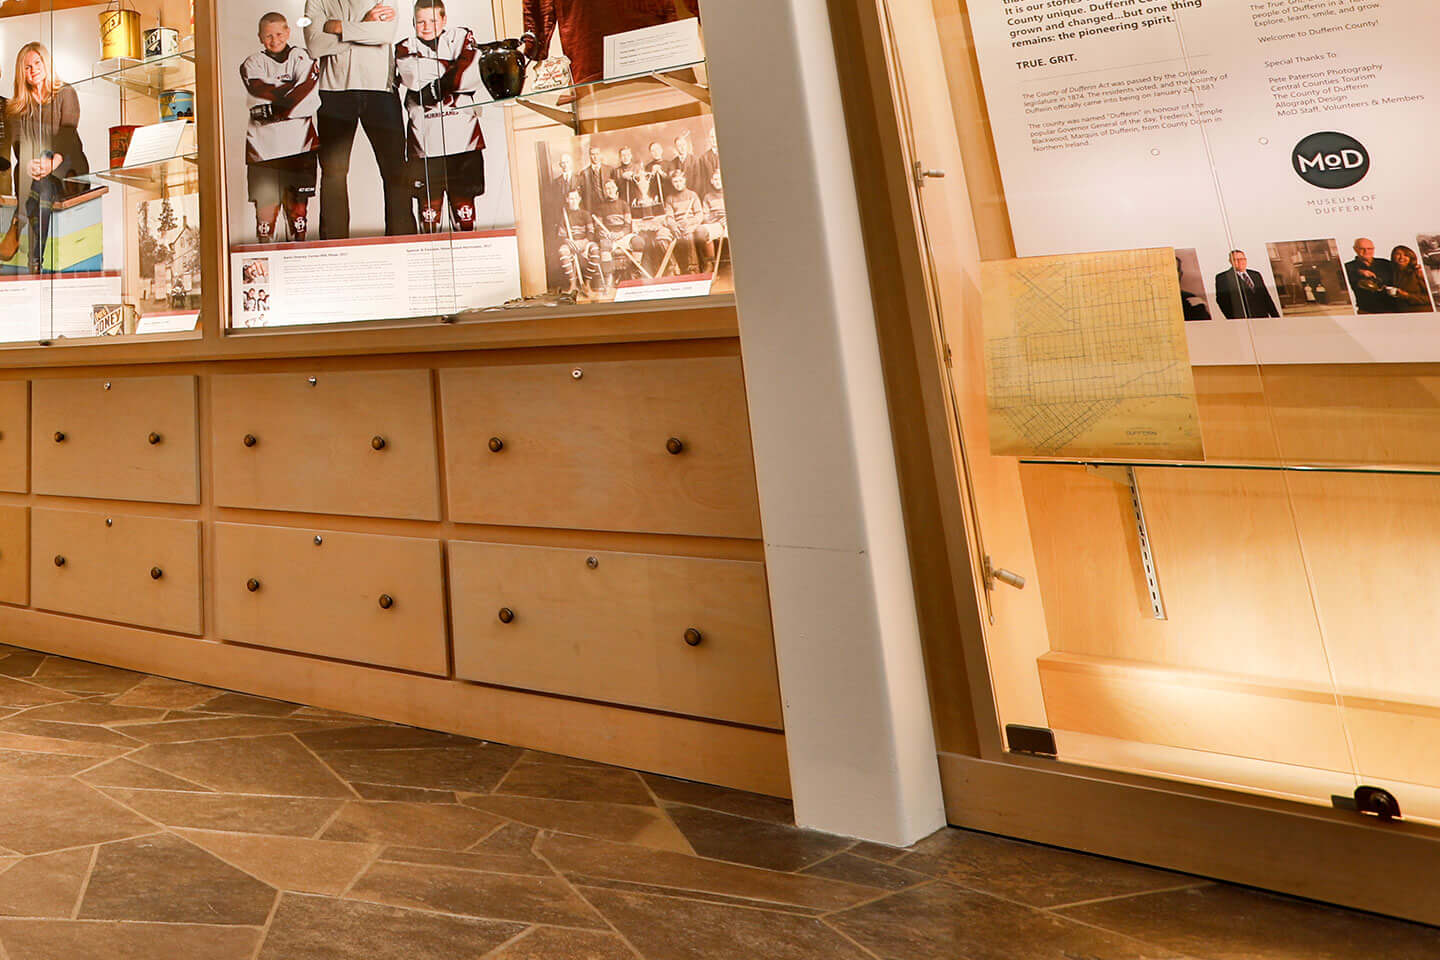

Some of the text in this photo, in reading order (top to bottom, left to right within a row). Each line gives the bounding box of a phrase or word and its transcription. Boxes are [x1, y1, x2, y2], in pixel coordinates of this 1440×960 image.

[1026, 3, 1043, 11] our
[1007, 15, 1044, 25] County
[1047, 8, 1086, 18] unique.
[1009, 26, 1042, 38] grown
[1045, 20, 1064, 30] and
[1146, 5, 1167, 14] one
[1171, 0, 1202, 9] thing
[1012, 15, 1175, 47] remains: the pioneering spirit.
[1258, 33, 1295, 42] Welcome
[1309, 25, 1343, 34] Dufferin
[1016, 54, 1077, 69] TRUE. GRIT.
[1264, 58, 1293, 67] Special
[1295, 54, 1324, 62] Thanks
[1326, 64, 1384, 75] Photography
[1271, 83, 1300, 91] Central
[1307, 197, 1356, 205] MUSEUM
[1315, 204, 1374, 214] DUFFERIN
